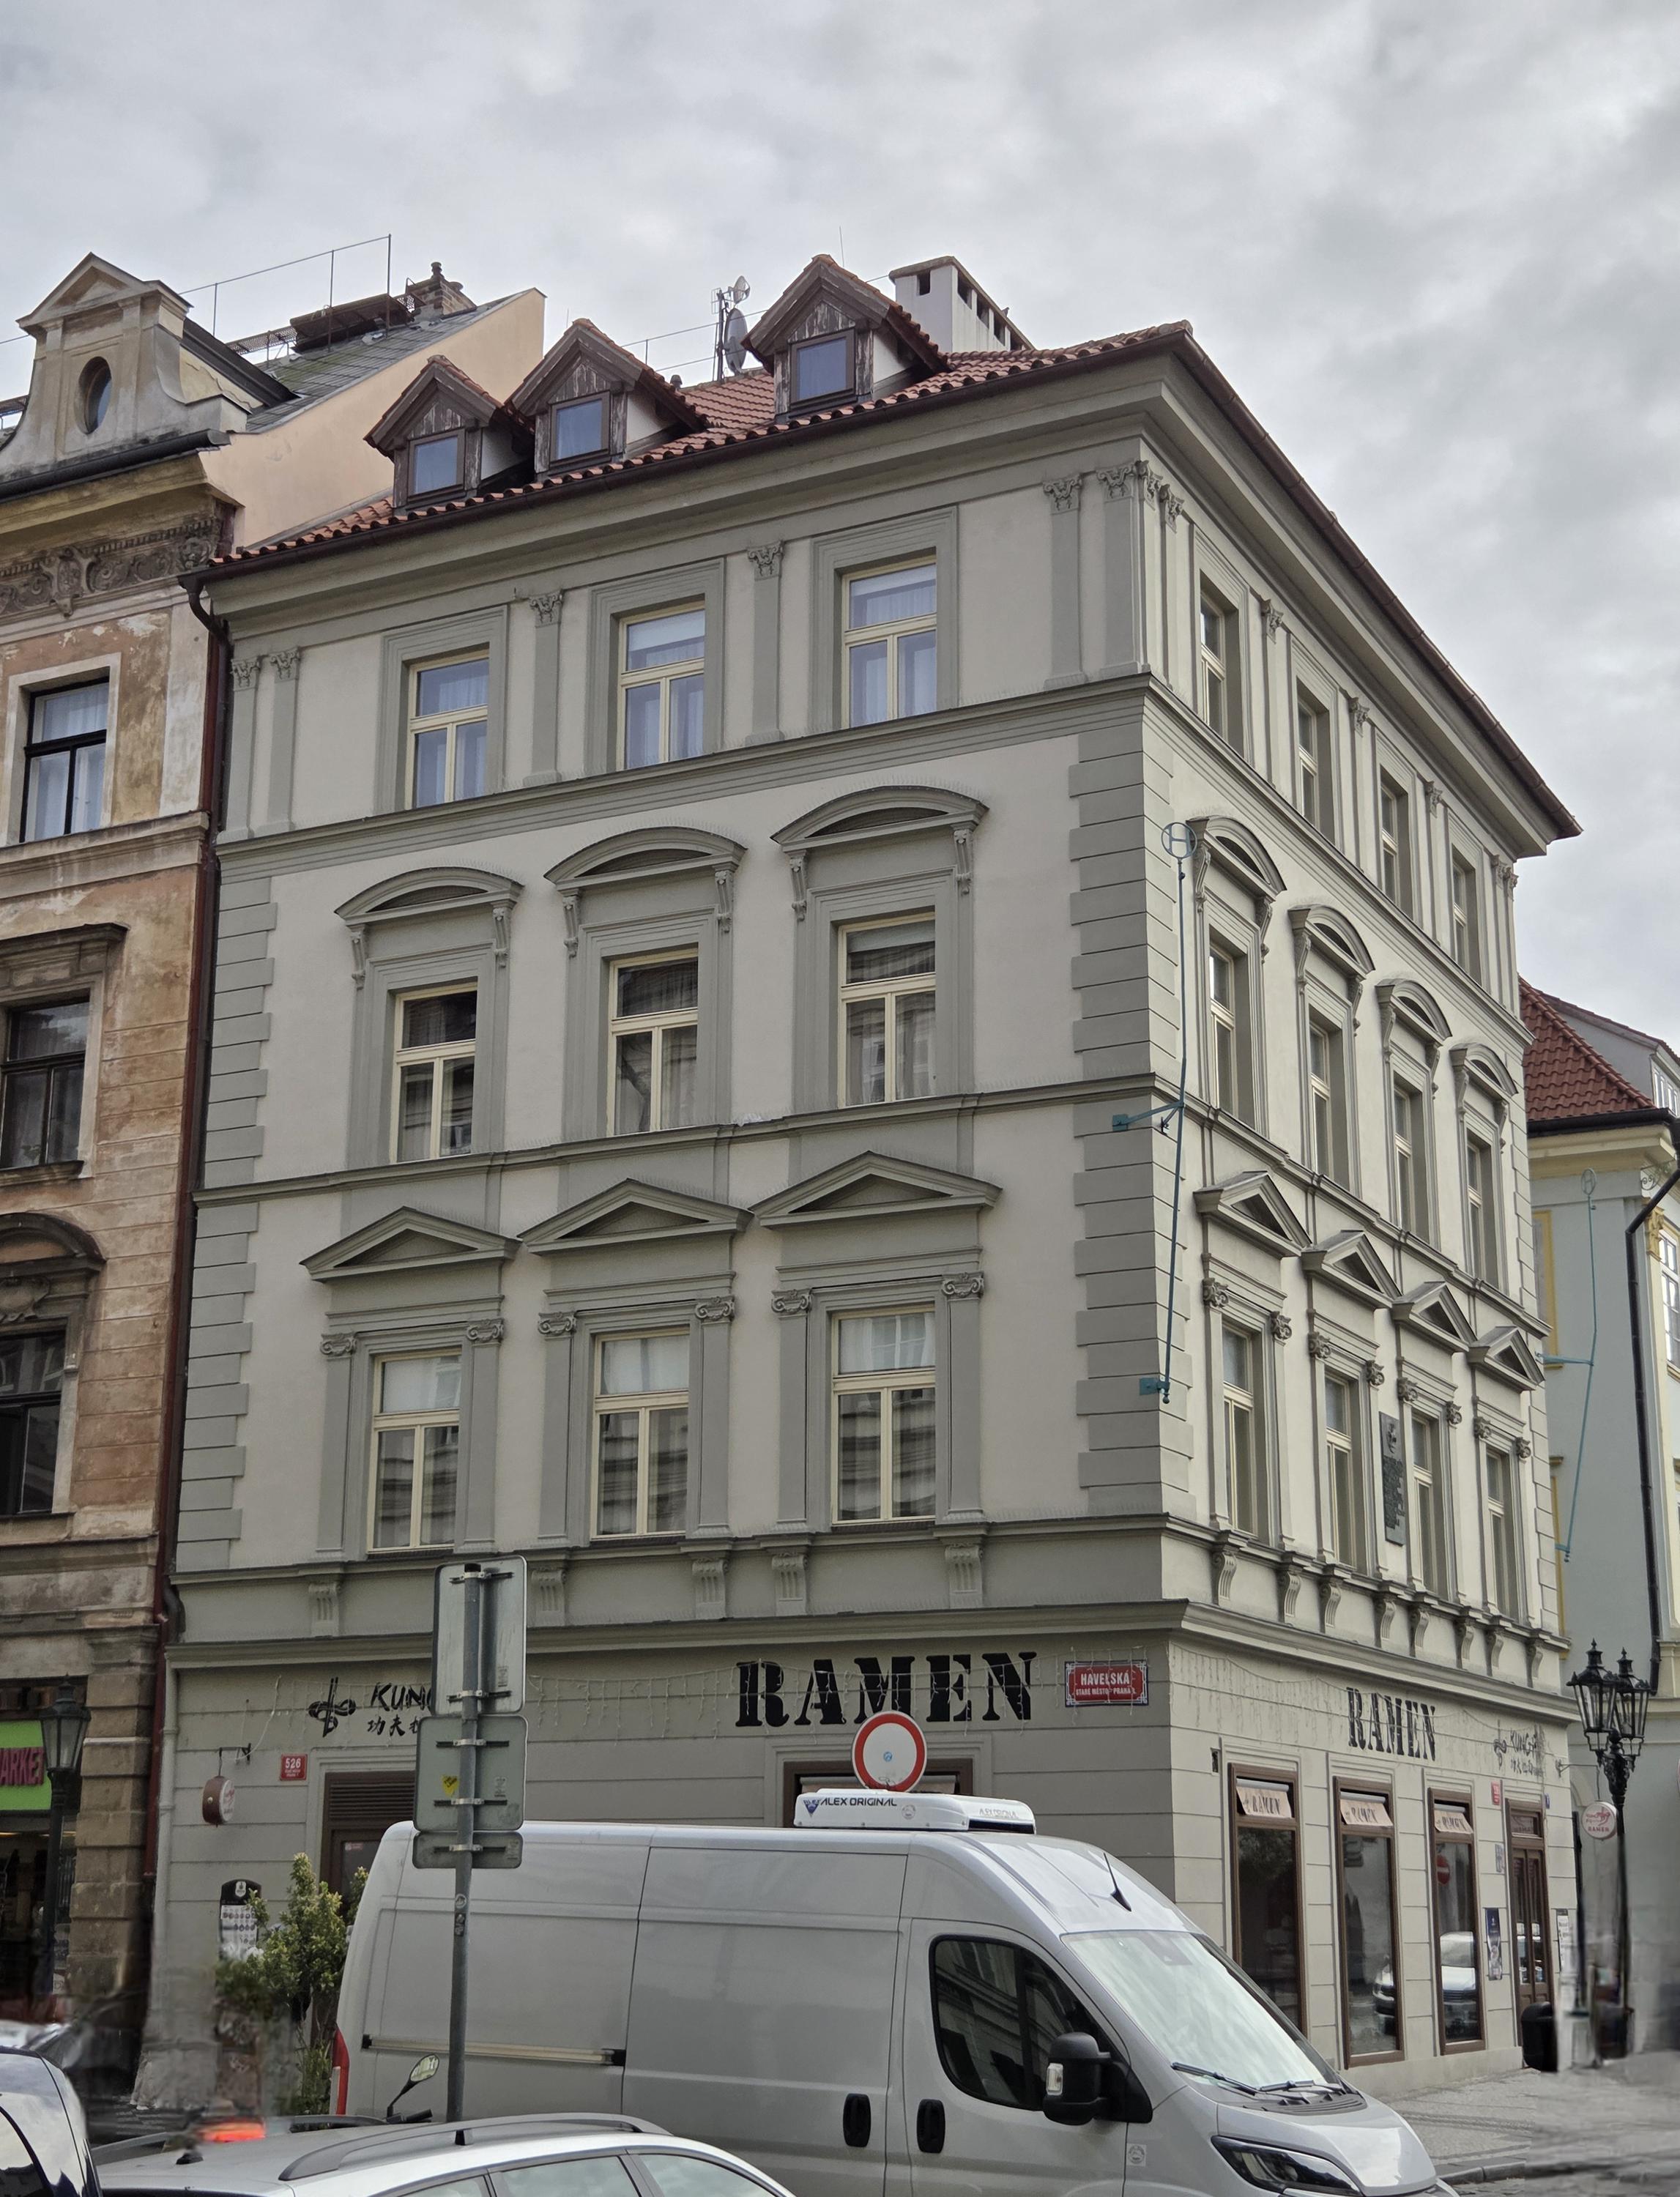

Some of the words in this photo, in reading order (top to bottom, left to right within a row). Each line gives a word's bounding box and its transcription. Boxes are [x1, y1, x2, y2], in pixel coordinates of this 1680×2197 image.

[1080, 1670, 1130, 1685] HAVELSKÁ
[735, 1651, 1037, 1727] RAMEN
[368, 1714, 418, 1736] 功夫
[1346, 1687, 1435, 1761] RAMEN
[286, 1758, 301, 1769] 526
[820, 1797, 847, 1806] ALEX
[850, 1797, 897, 1807] ORIGINAL
